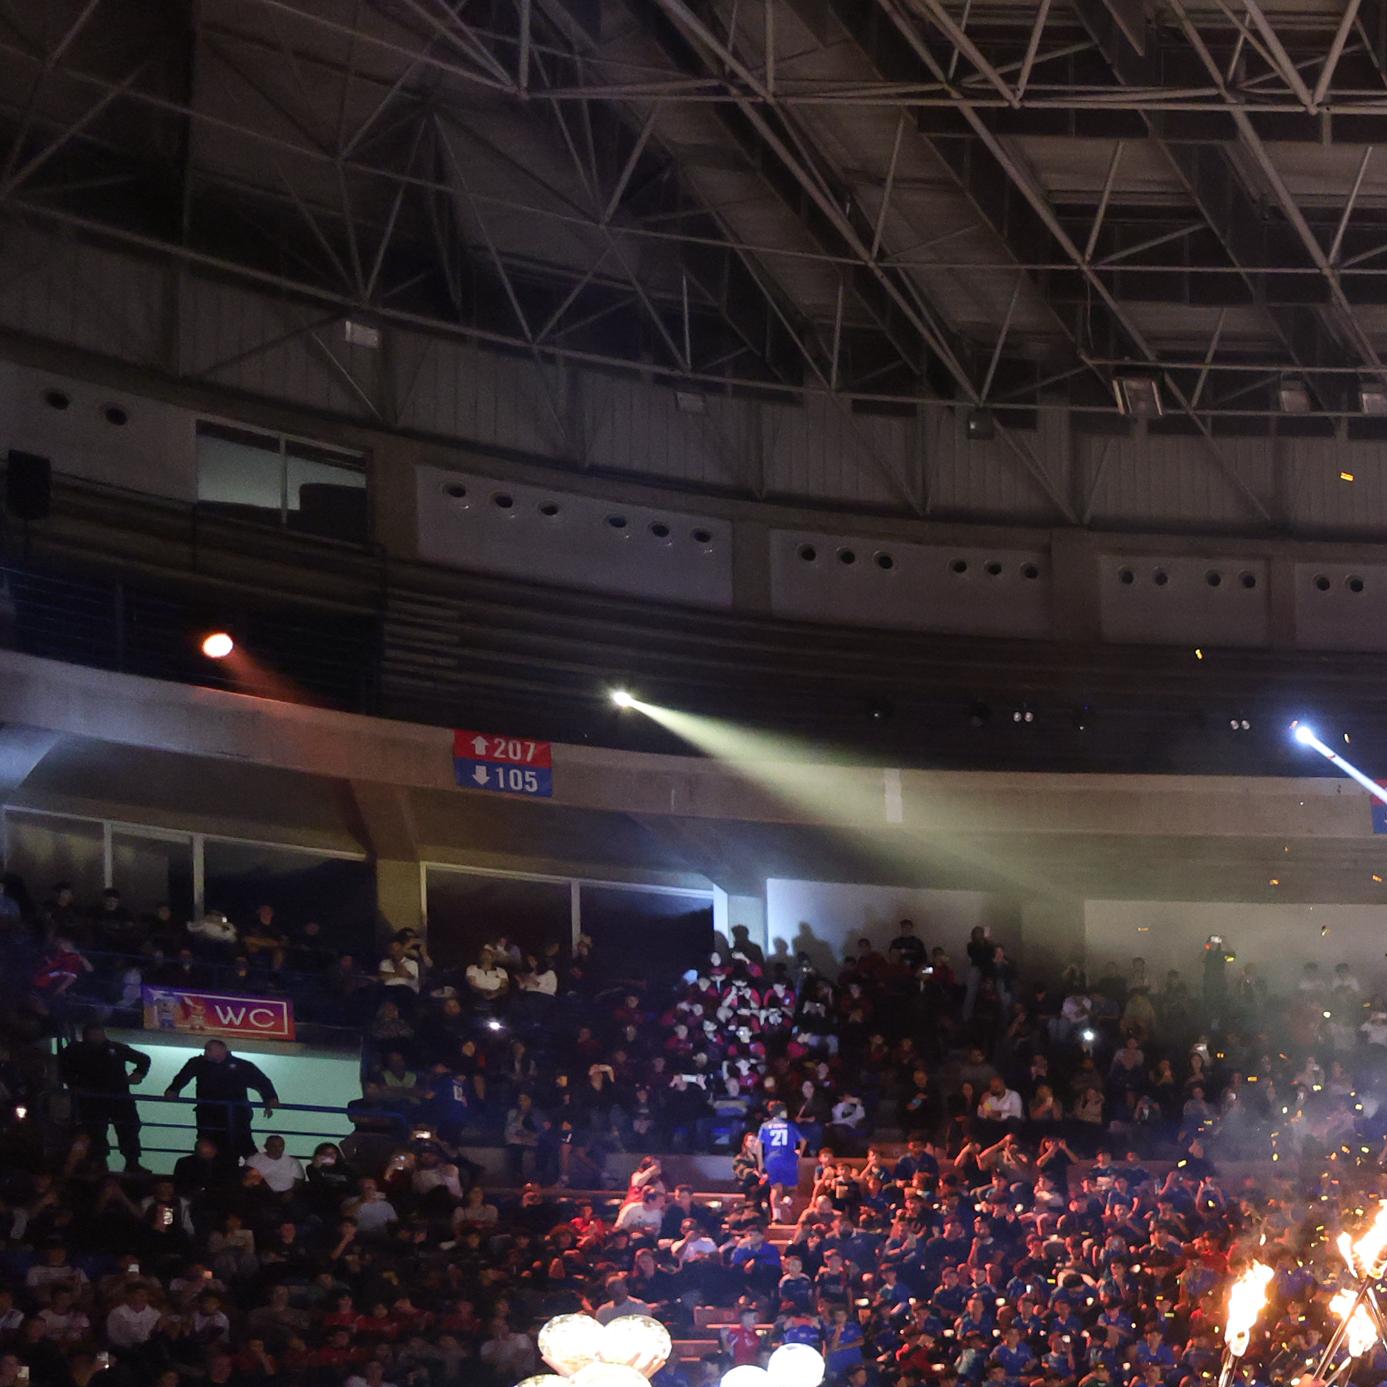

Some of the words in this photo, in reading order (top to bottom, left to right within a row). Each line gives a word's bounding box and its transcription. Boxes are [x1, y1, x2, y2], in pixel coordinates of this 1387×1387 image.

[493, 738, 536, 762] 207
[495, 767, 538, 792] 105
[215, 1005, 275, 1028] WC
[769, 1129, 788, 1147] 21
